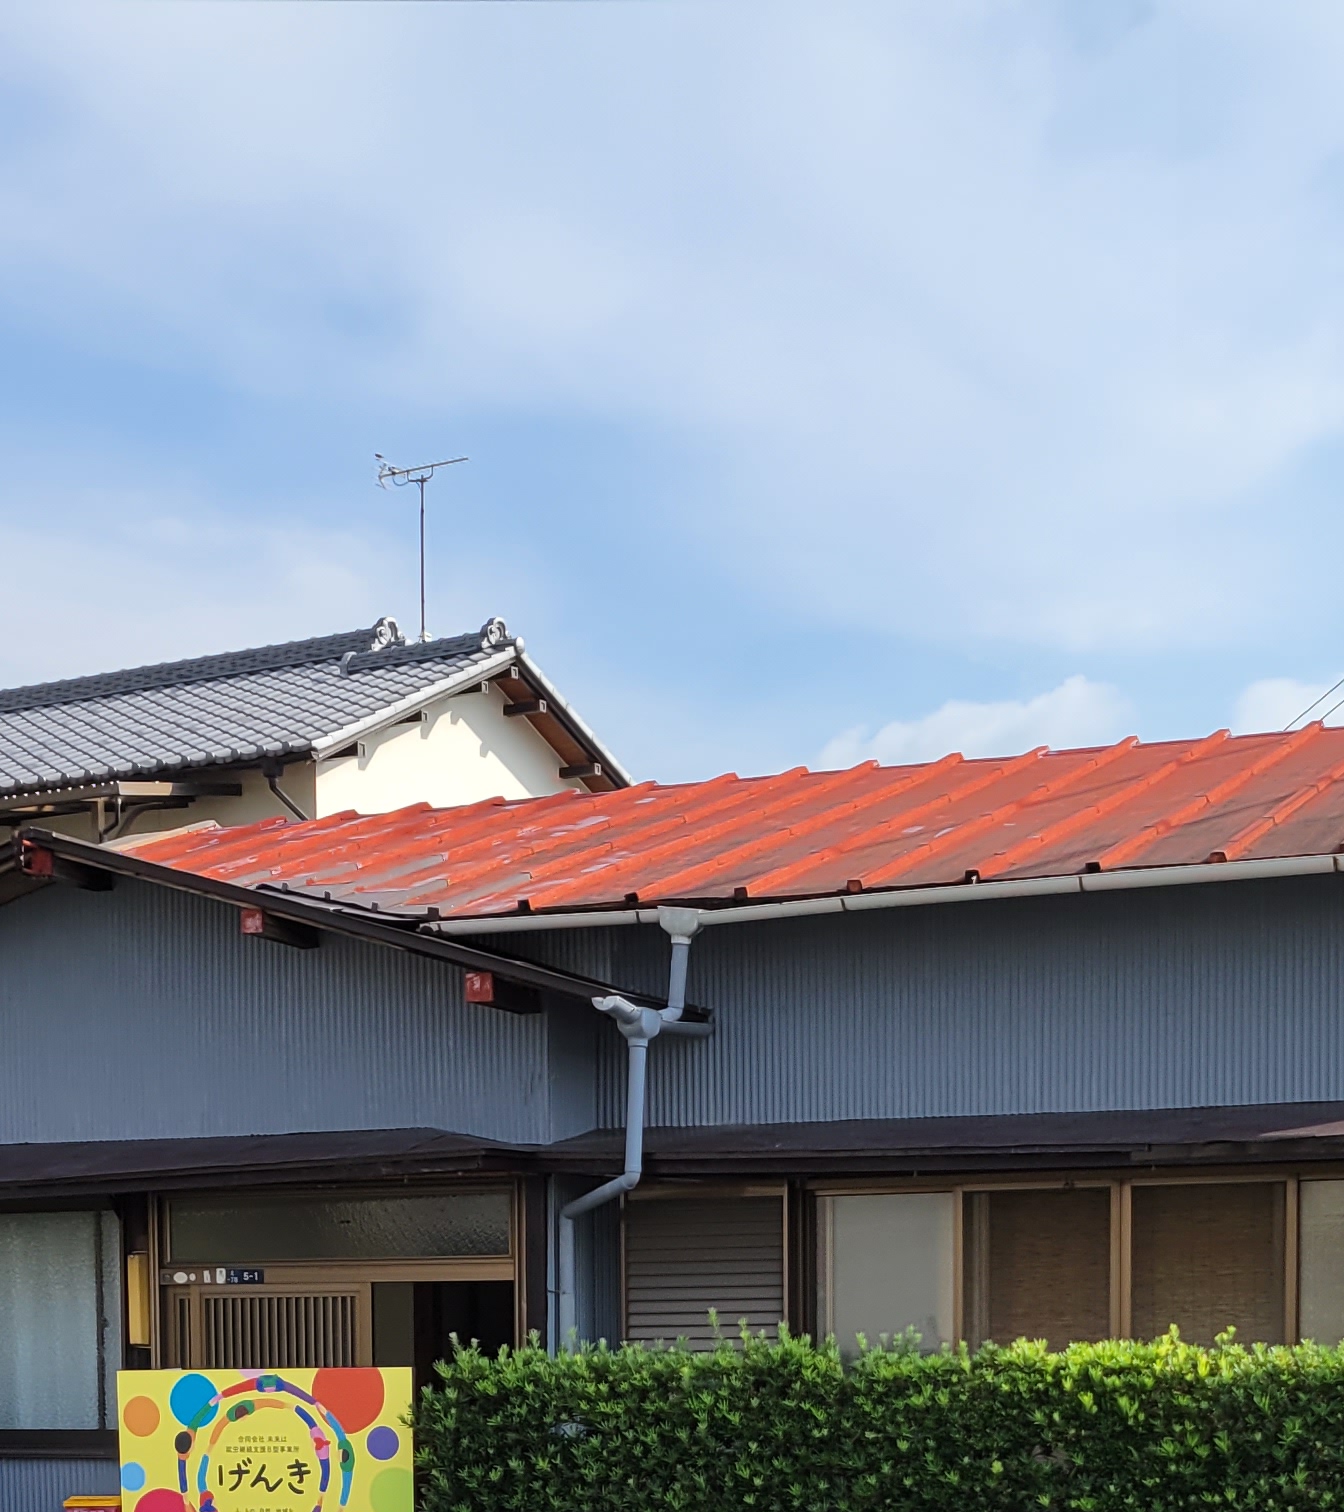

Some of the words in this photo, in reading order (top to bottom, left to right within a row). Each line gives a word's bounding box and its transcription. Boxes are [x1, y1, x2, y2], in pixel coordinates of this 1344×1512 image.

[243, 1271, 258, 1281] 5-1
[218, 1457, 311, 1494] げんき
